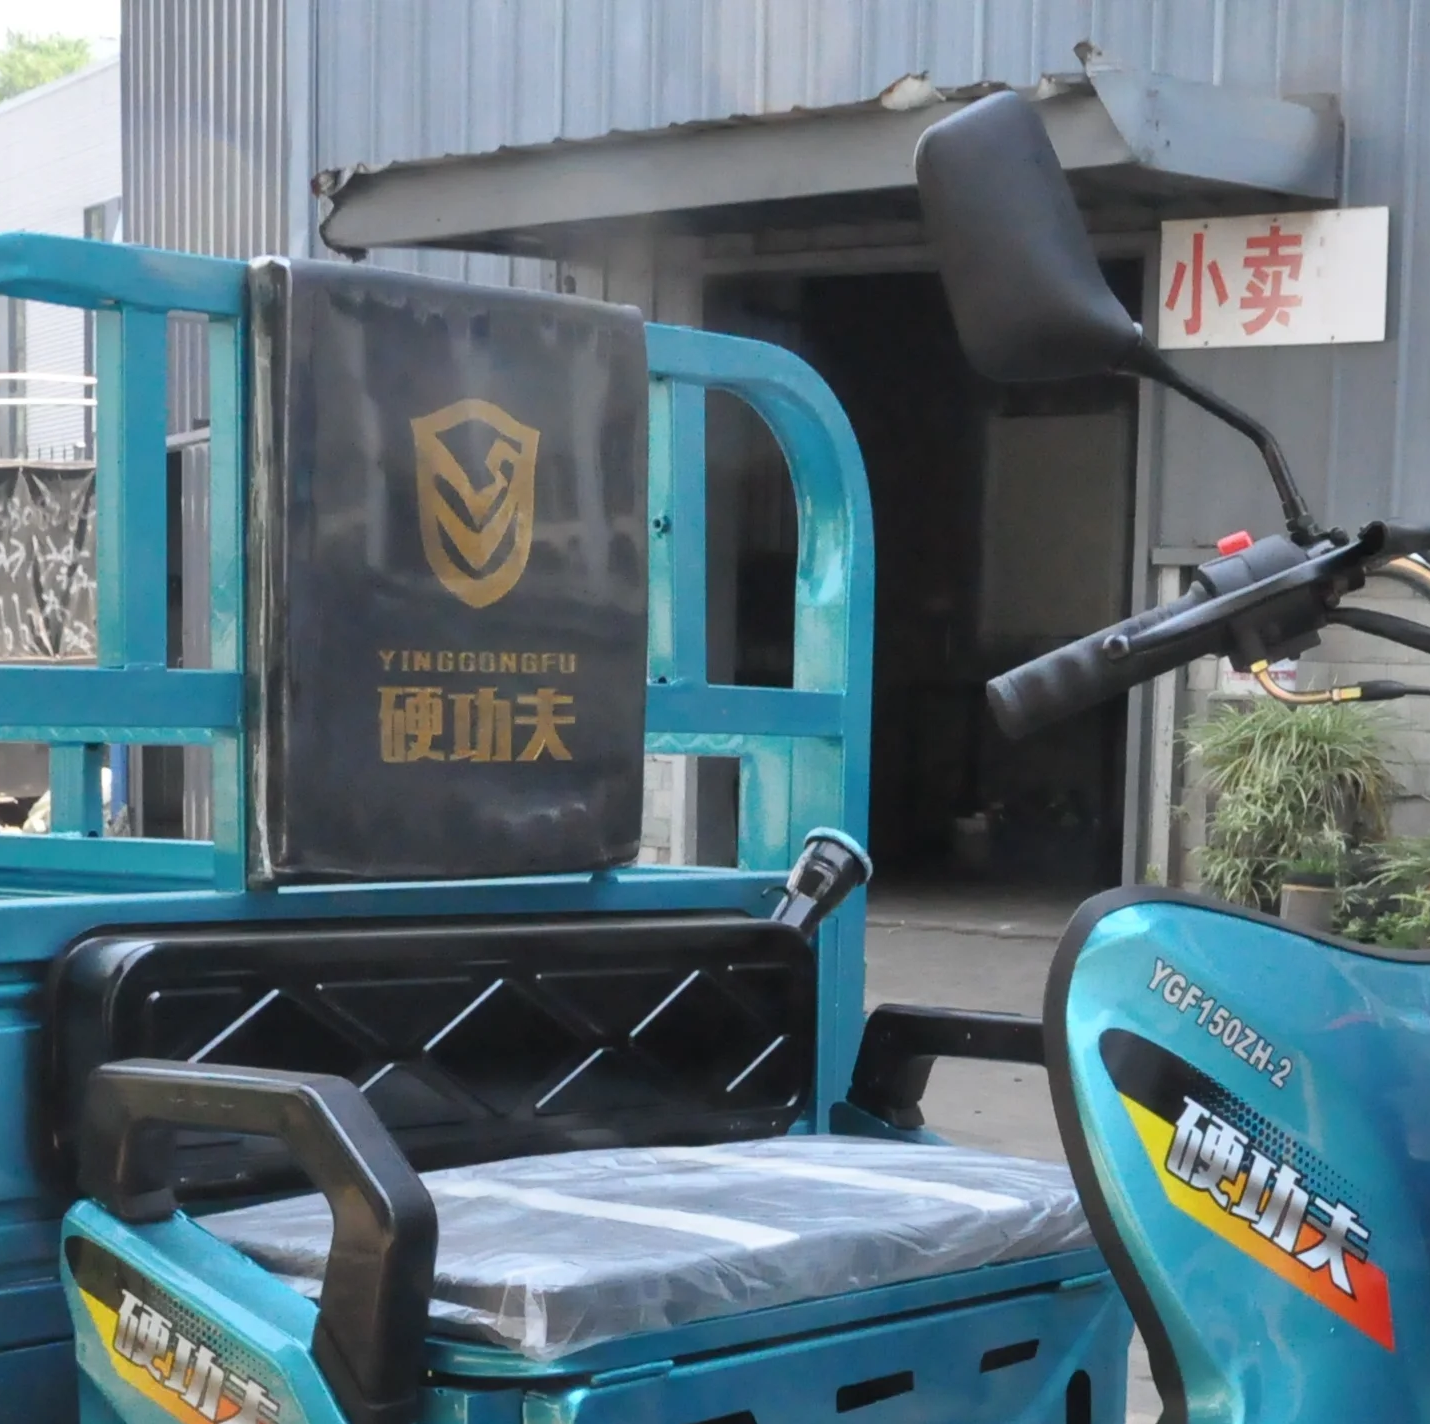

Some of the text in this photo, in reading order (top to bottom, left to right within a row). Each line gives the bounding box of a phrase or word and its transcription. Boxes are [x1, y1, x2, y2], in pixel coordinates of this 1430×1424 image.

[1164, 225, 1303, 336] 小卖
[378, 649, 578, 675] YINGGONGFU
[377, 686, 576, 763] 硬功夫
[1147, 957, 1294, 1089] YGF150ZH-2
[1165, 1096, 1371, 1301] 硬功夫
